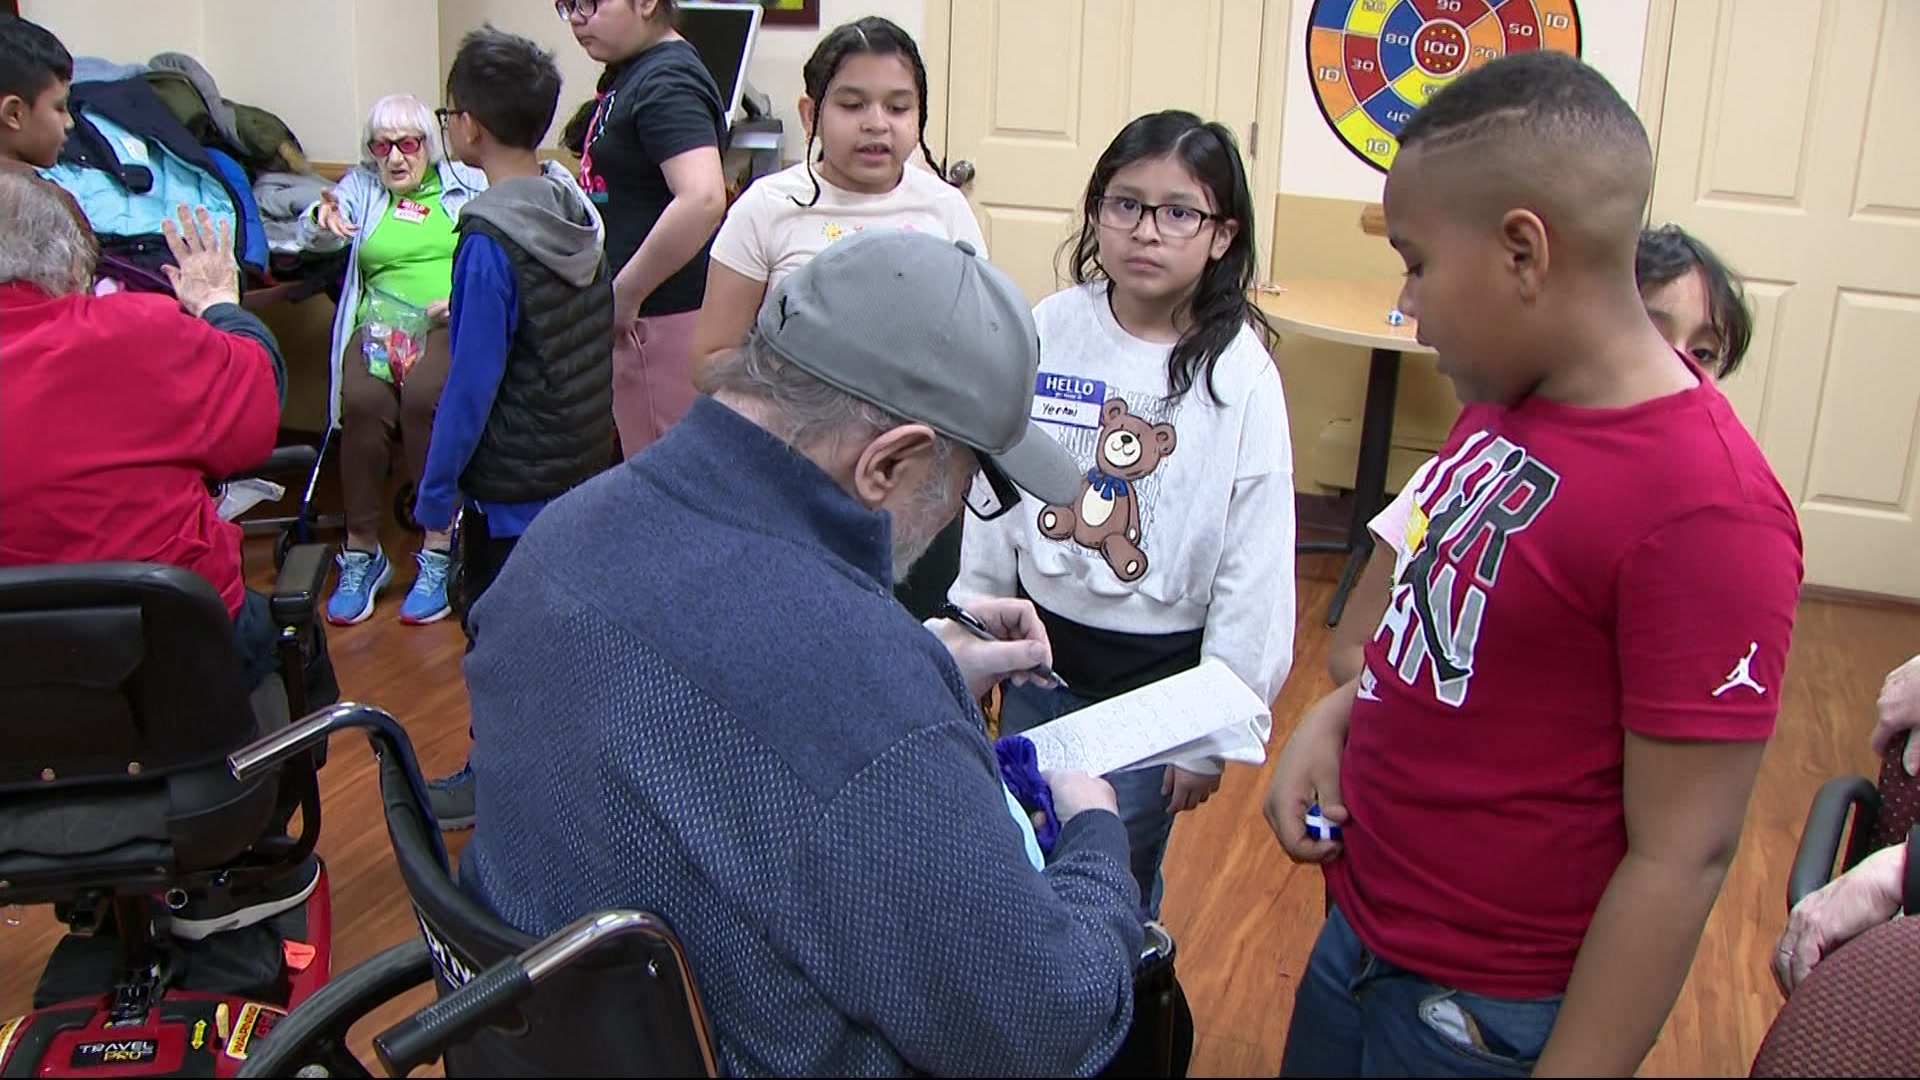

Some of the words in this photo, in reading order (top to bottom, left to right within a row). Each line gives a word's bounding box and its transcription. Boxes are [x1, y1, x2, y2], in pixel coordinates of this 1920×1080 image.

[1545, 12, 1568, 29] 10
[1508, 22, 1533, 37] 50
[1385, 32, 1410, 47] 80
[1423, 39, 1459, 57] 100
[1351, 58, 1375, 72] 30
[1318, 67, 1340, 83] 10
[1386, 109, 1411, 123] 40
[1366, 139, 1390, 154] 10
[1045, 376, 1094, 396] HELLO
[1373, 563, 1488, 707] AN
[79, 1041, 154, 1054] TRAVEL
[103, 1051, 143, 1062] PRO
